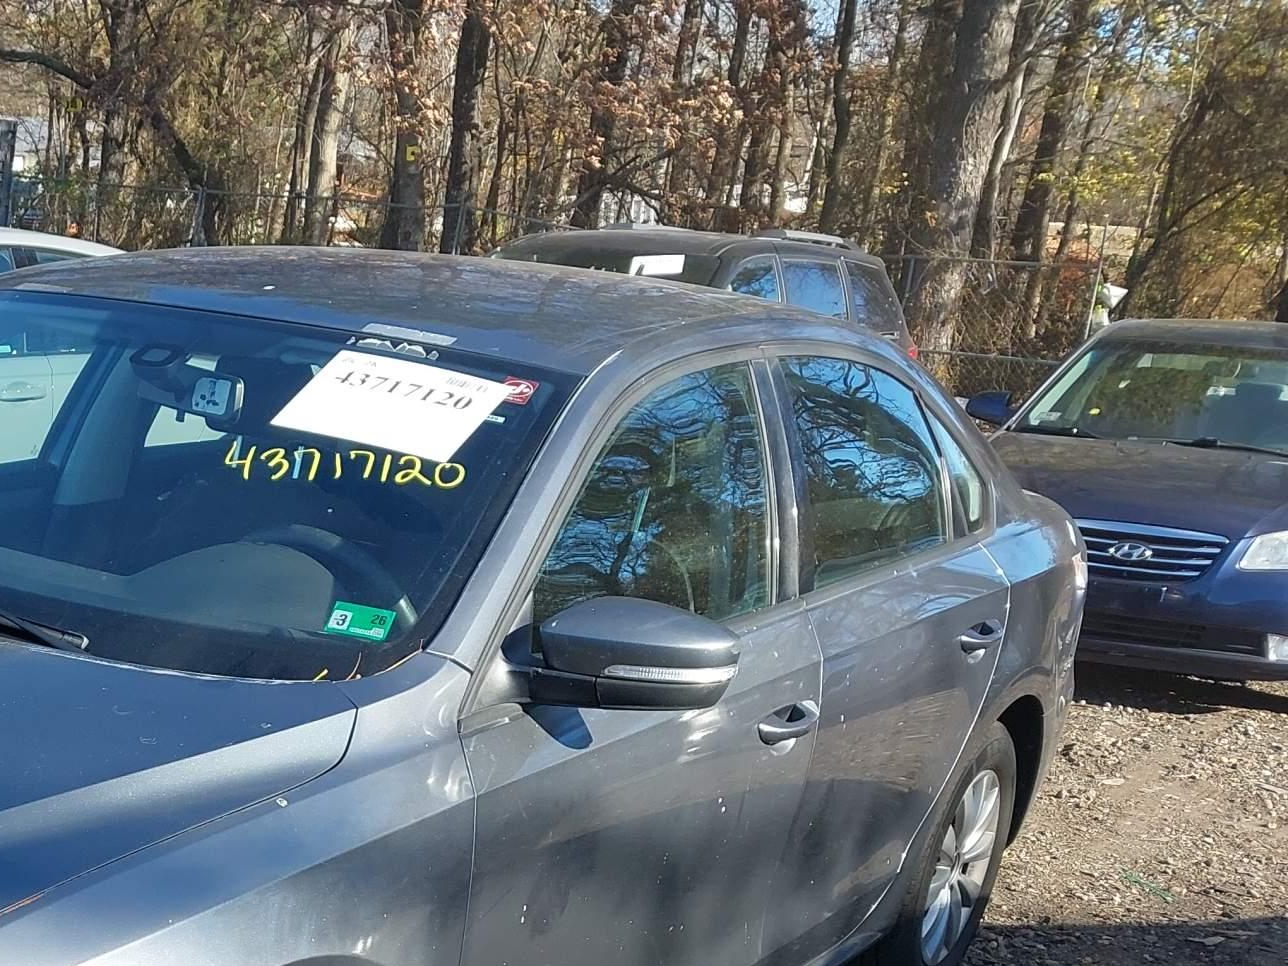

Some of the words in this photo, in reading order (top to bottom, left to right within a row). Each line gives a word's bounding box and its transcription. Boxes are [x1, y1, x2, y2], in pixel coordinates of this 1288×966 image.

[335, 370, 473, 410] 43717120
[223, 440, 467, 489] 43717120
[370, 614, 388, 626] 26
